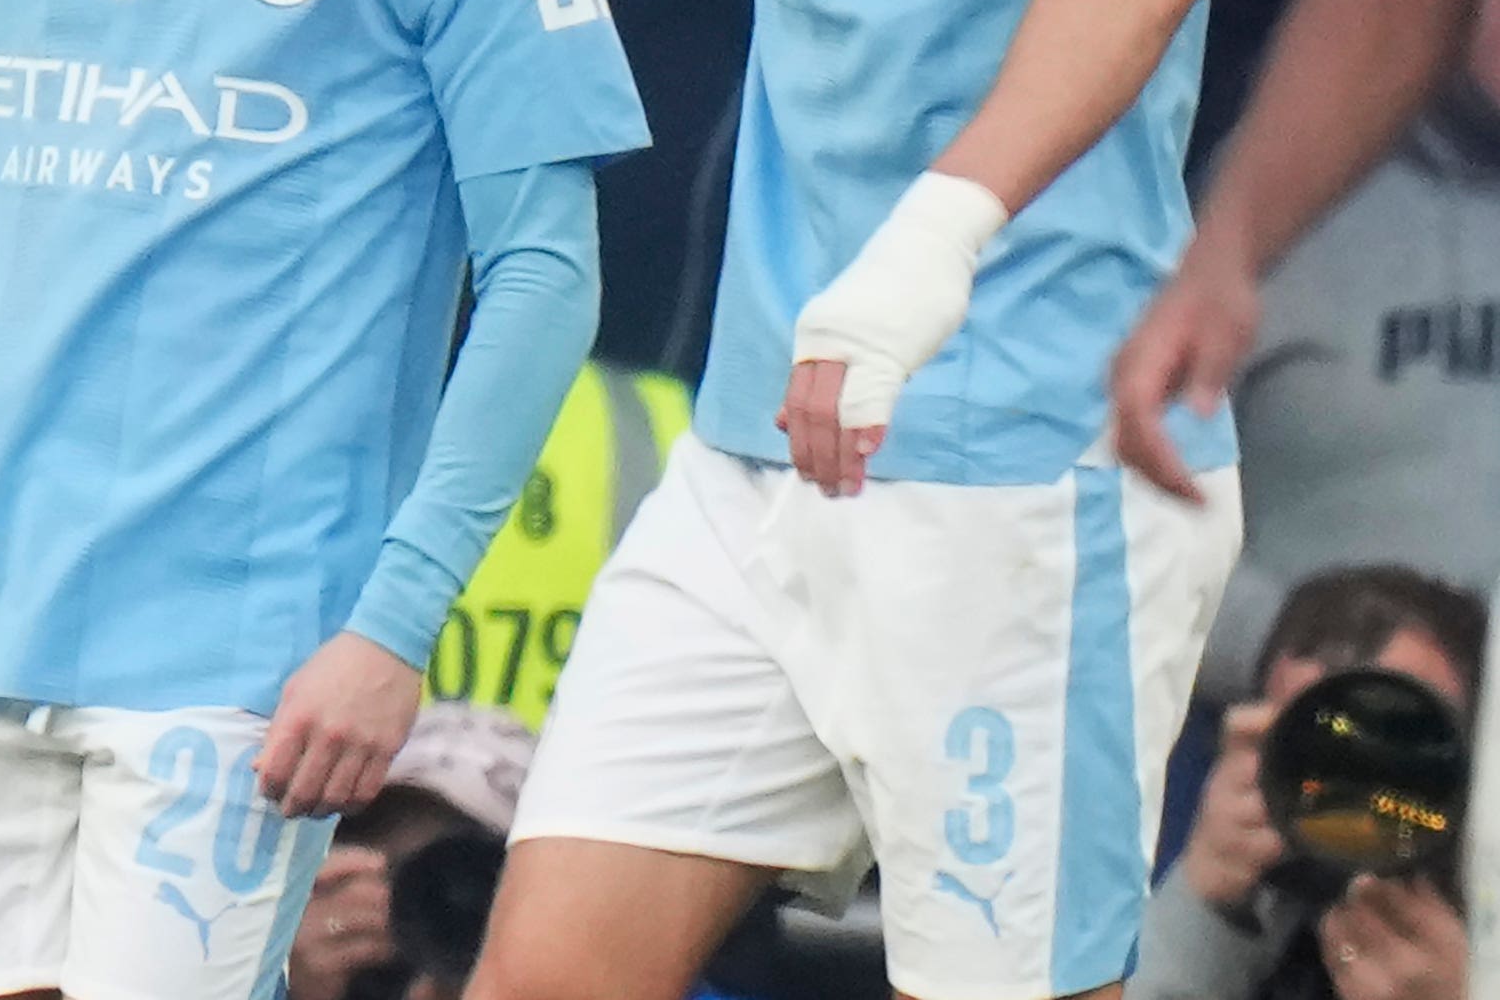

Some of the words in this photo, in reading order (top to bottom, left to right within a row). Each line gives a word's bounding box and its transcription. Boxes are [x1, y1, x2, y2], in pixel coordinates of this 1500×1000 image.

[0, 145, 213, 200] AIRWAYS
[134, 725, 284, 894] 20
[944, 706, 1016, 866] 3
